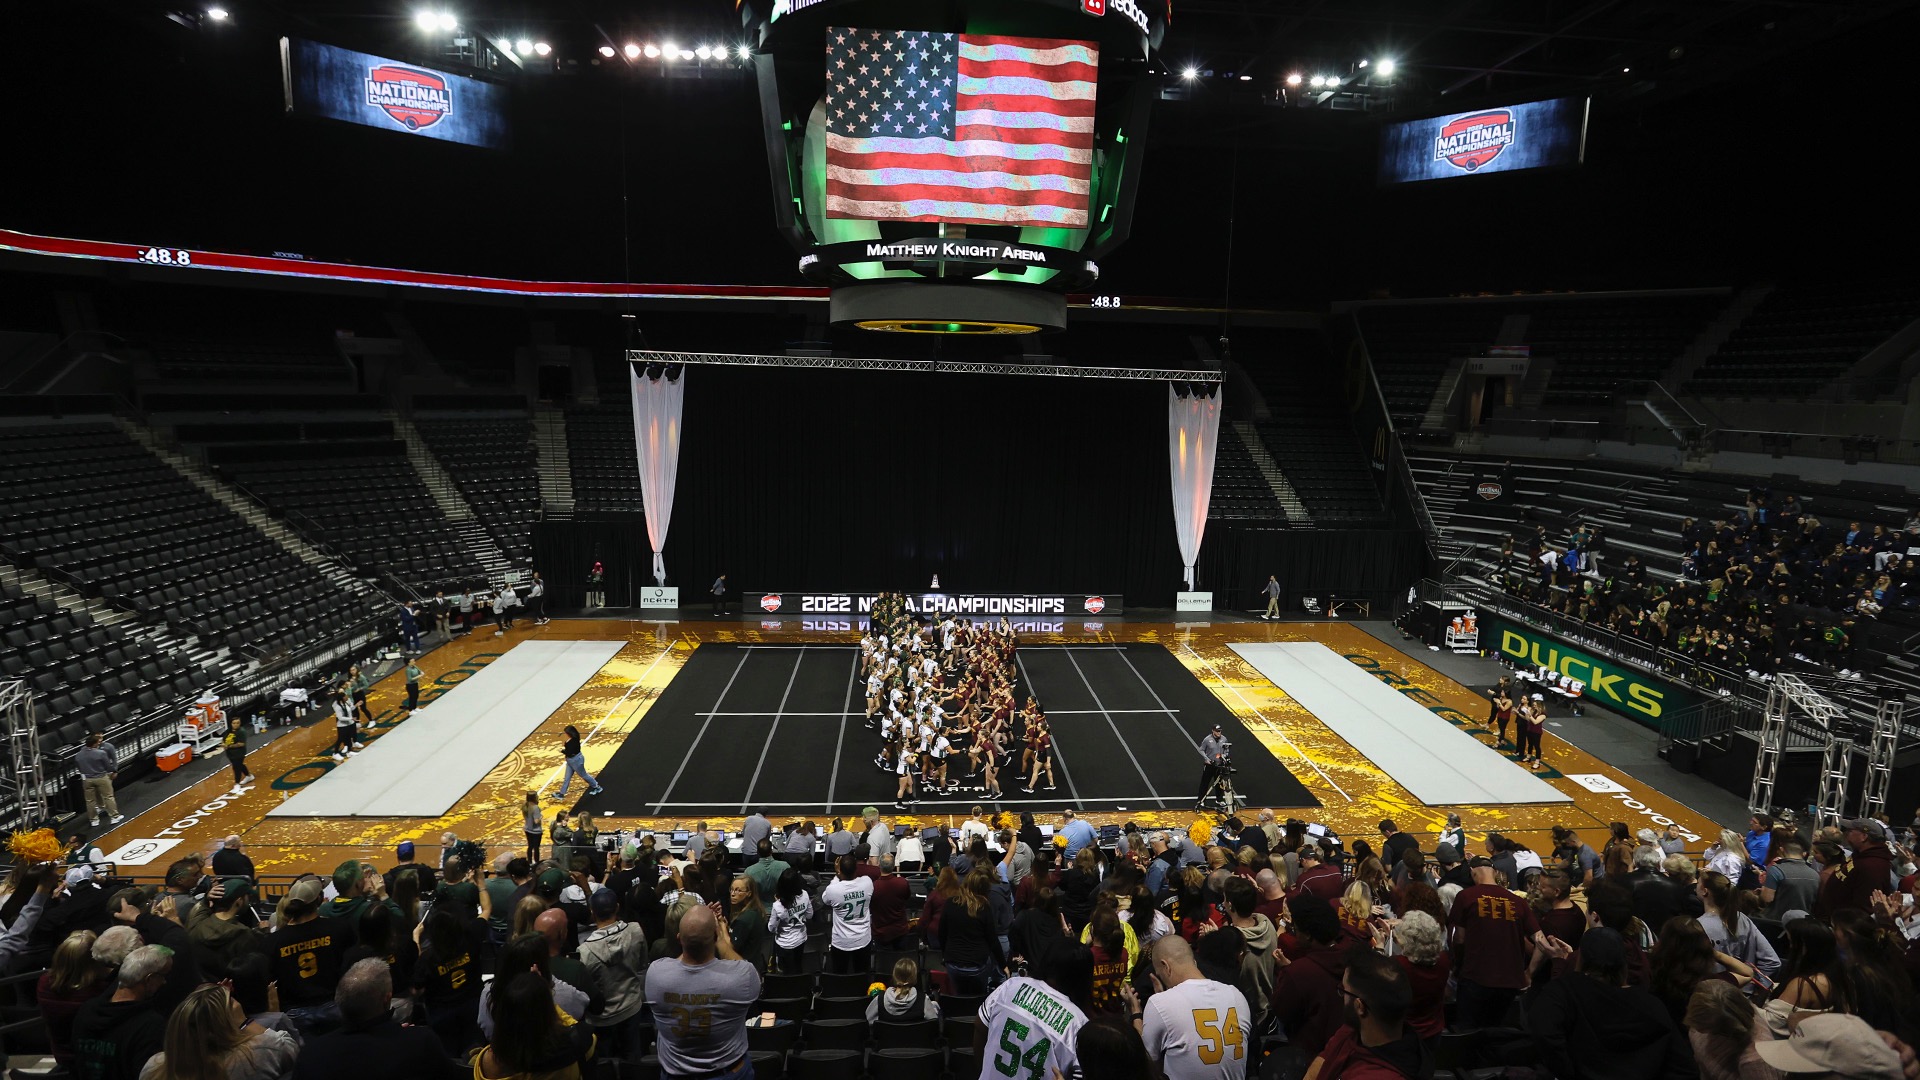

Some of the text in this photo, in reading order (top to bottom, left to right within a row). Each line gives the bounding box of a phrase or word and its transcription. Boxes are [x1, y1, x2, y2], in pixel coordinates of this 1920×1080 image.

[369, 81, 448, 103] NATIONAL
[370, 95, 449, 112] CHAMPIONSHIPS
[1437, 135, 1511, 158] CHAMPIONSHIPS
[1438, 125, 1511, 150] NATIONAL
[138, 248, 190, 265] :48.8
[867, 242, 1046, 262] MATTHEW KNIGHT ARENA
[1091, 296, 1121, 308] :48.8
[802, 596, 851, 612] 2022
[922, 597, 1065, 613] CHAMPIONSHIPS
[1501, 629, 1664, 718] DUCKS
[843, 890, 865, 901] HARRIS
[843, 899, 867, 920] 27
[280, 936, 331, 957] KITCHENS
[298, 952, 318, 979] 9
[1012, 982, 1075, 1036] KALOOSTIAN
[1192, 1006, 1244, 1065] 54
[994, 1016, 1051, 1080] 54
